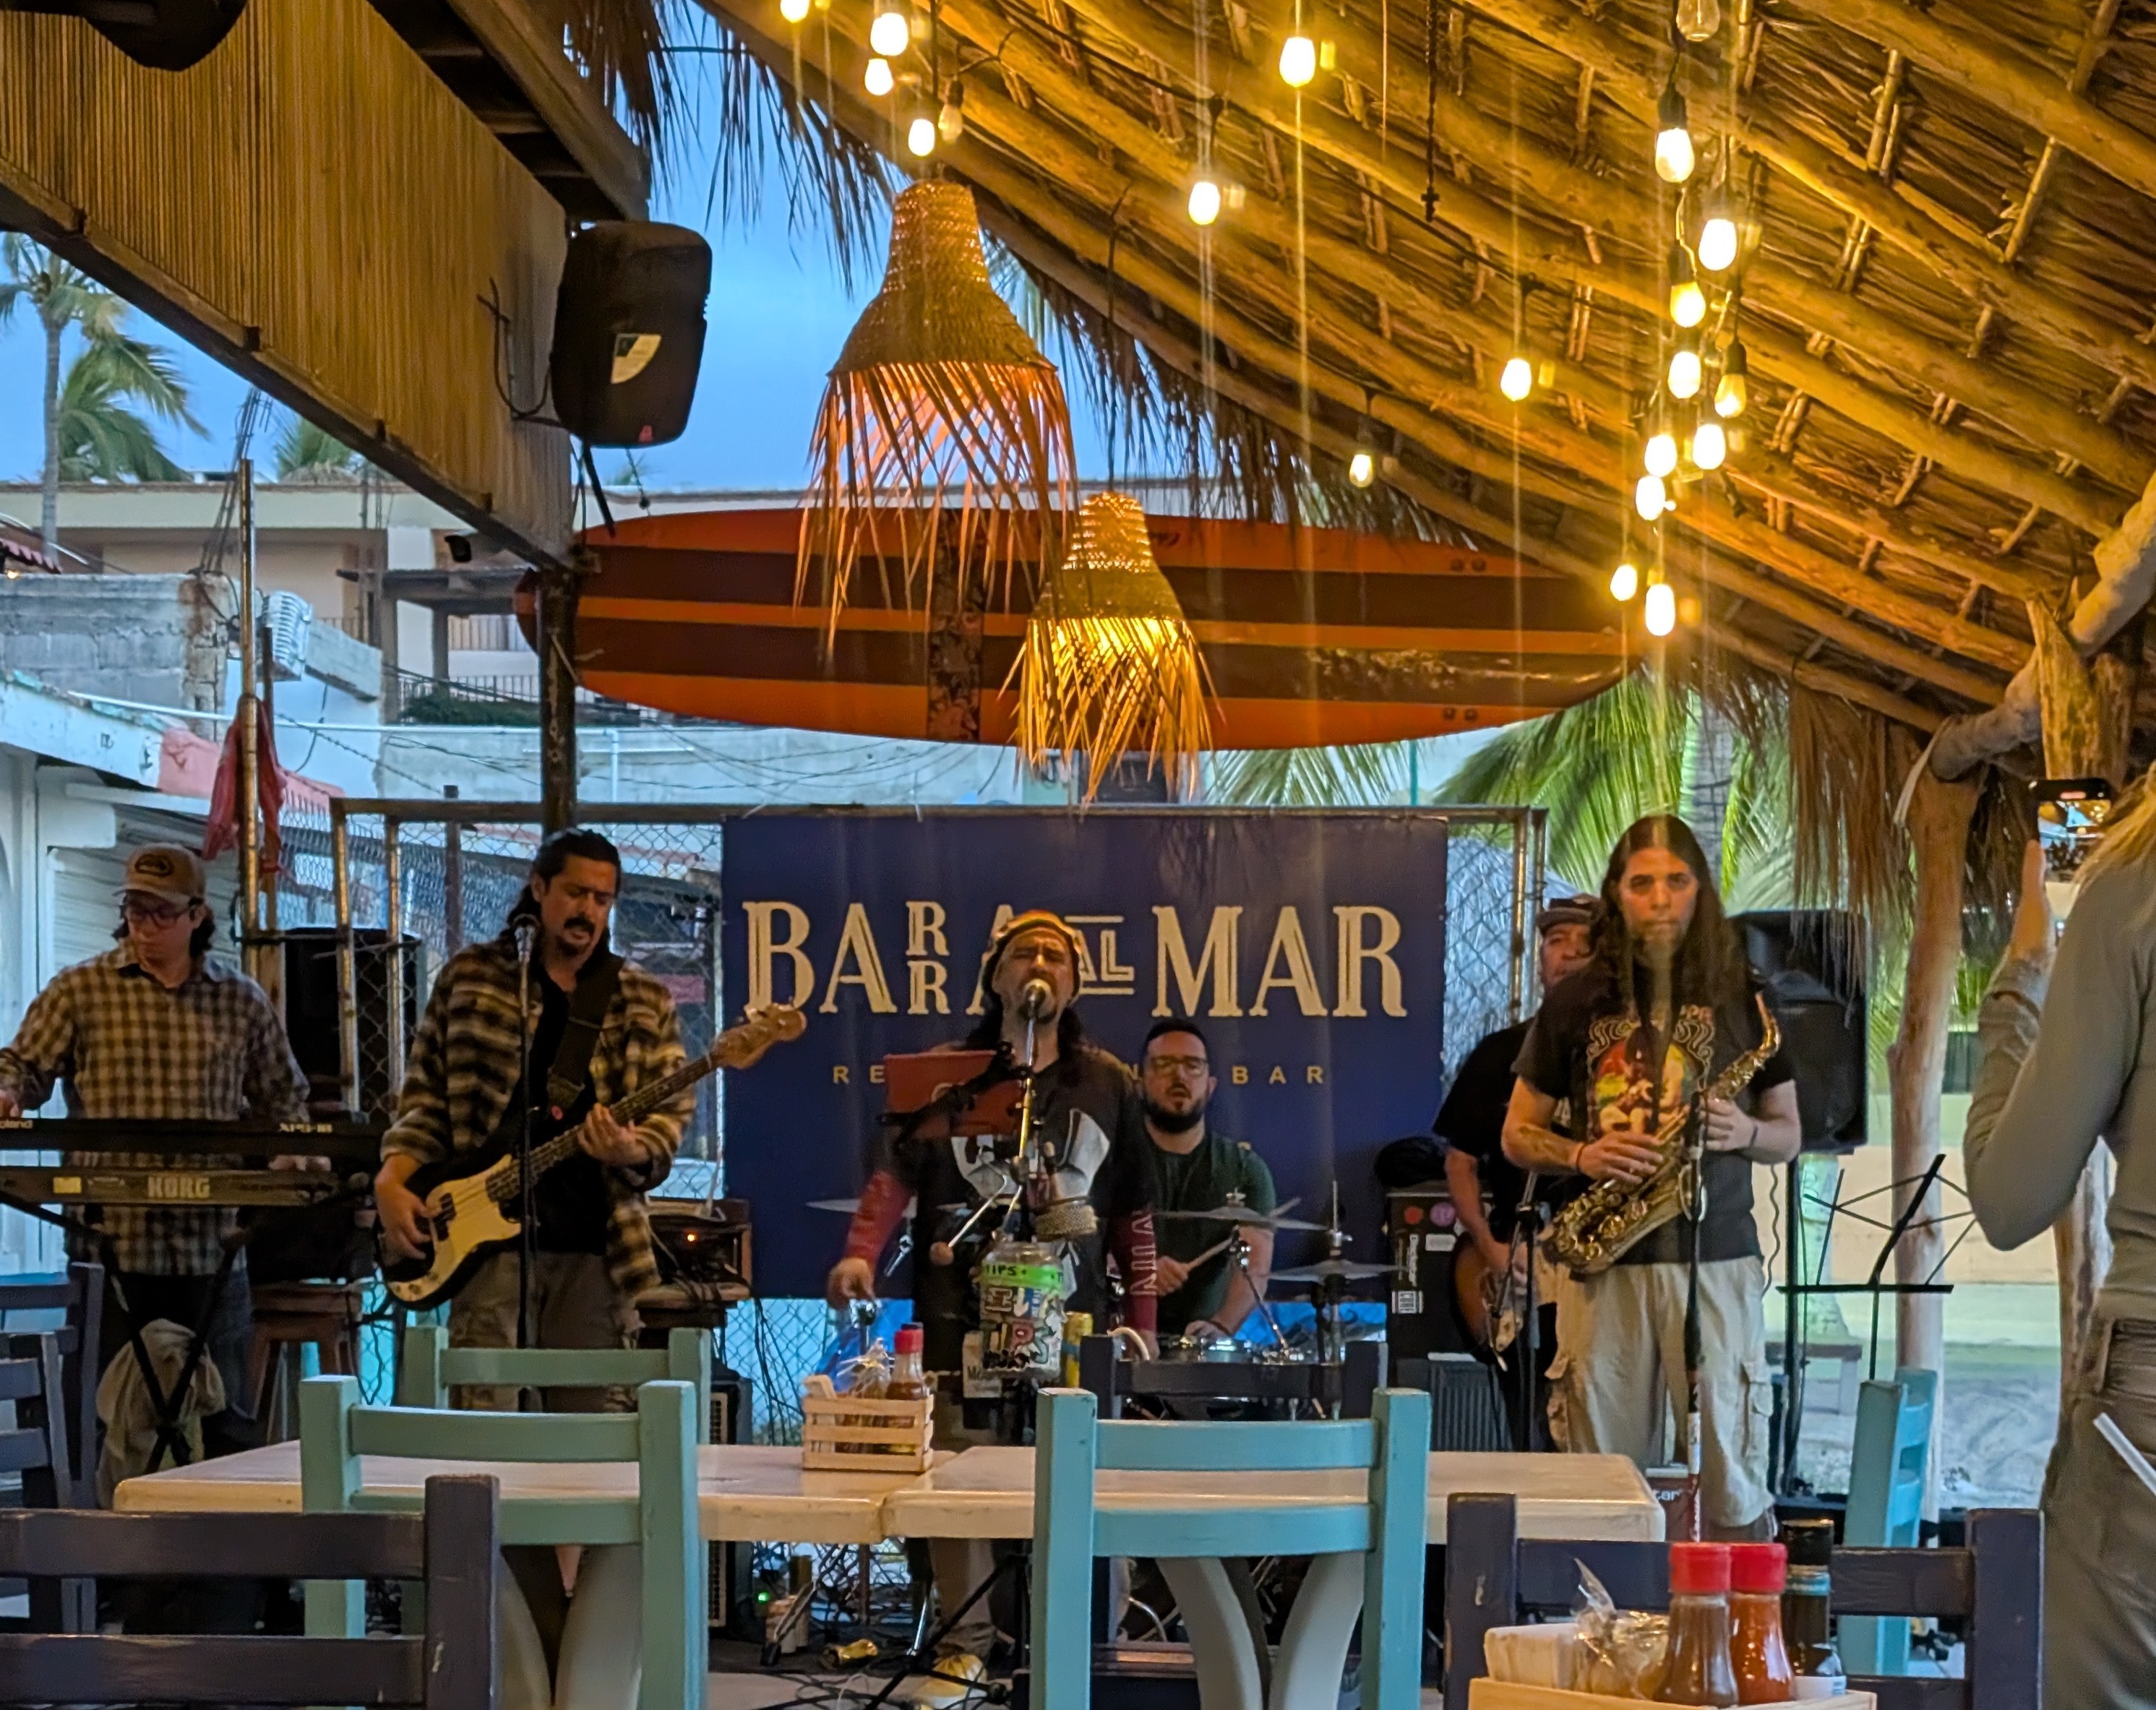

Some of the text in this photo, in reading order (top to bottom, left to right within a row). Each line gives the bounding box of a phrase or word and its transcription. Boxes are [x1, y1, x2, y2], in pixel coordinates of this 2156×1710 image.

[1151, 906, 1407, 1017] MAR
[1232, 1065, 1324, 1084] BAR
[0, 1120, 33, 1129] oland
[147, 1176, 210, 1198] KORG
[985, 1264, 1016, 1276] TIPS
